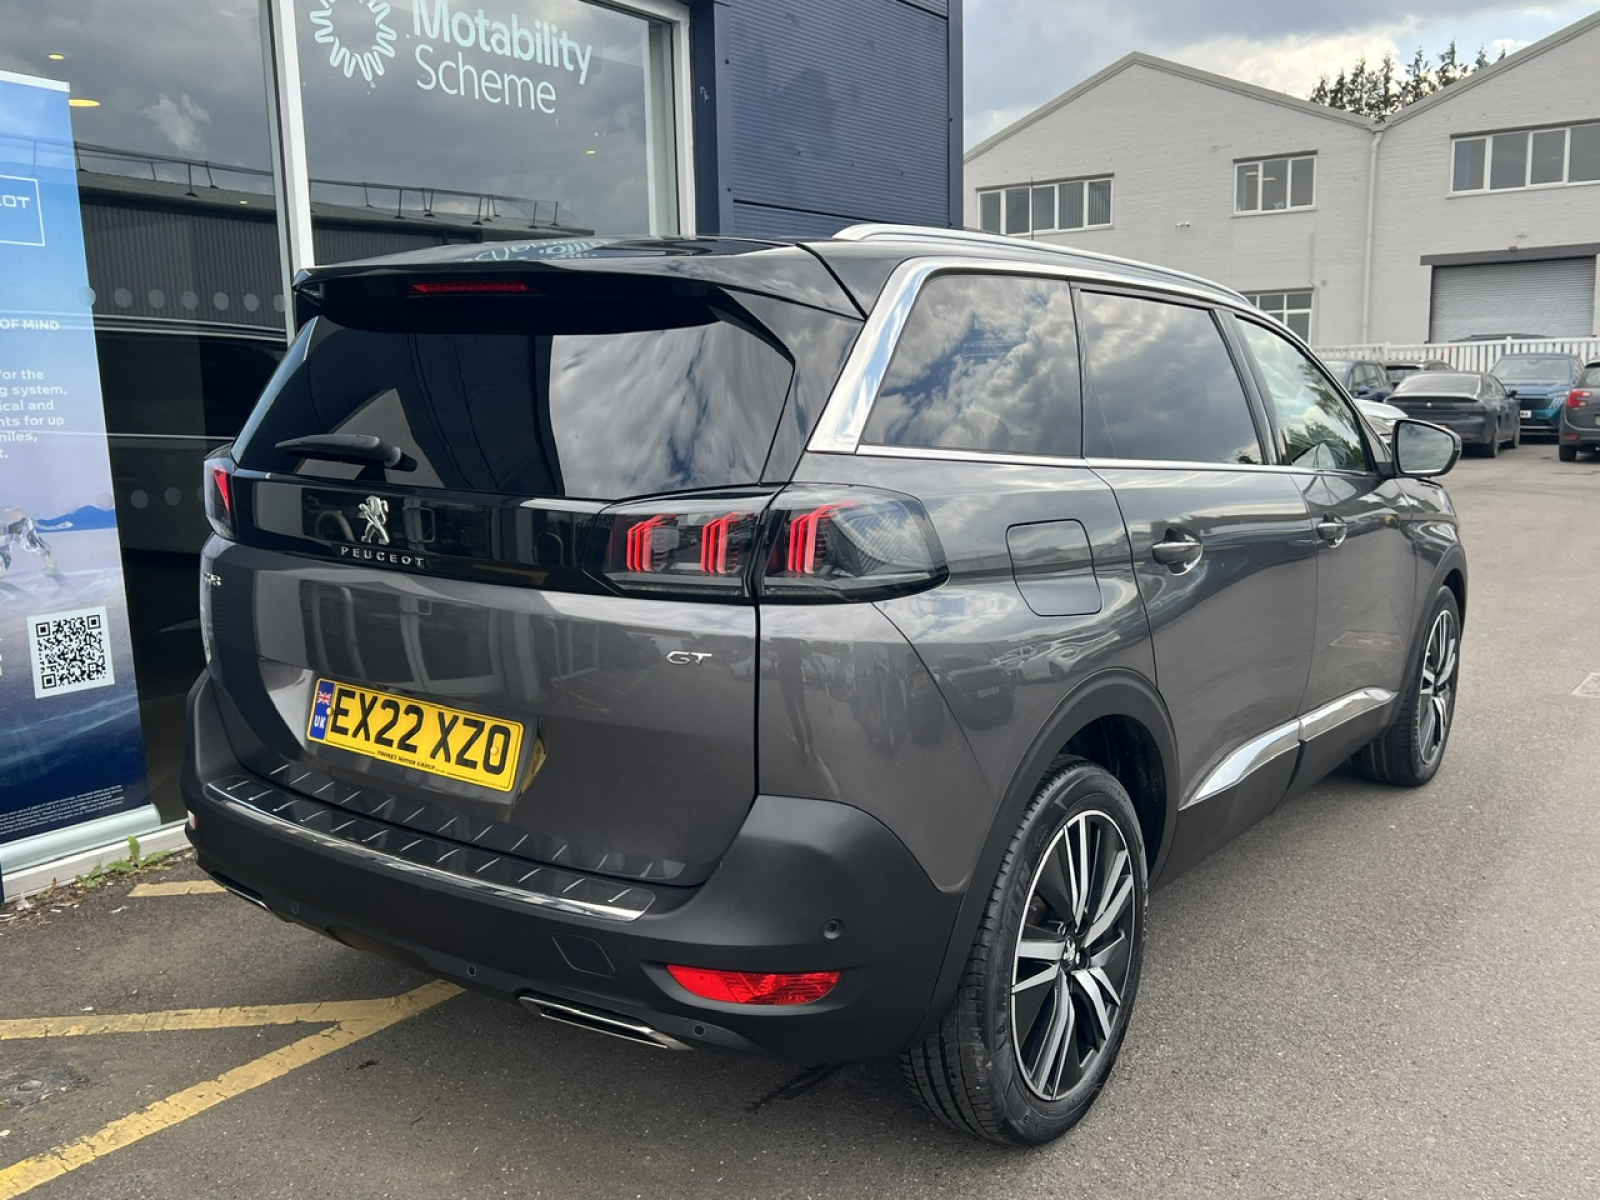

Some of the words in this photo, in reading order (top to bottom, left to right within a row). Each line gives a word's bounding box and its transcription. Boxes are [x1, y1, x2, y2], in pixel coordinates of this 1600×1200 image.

[411, 0, 593, 86] Motability
[414, 44, 557, 115] Scheme
[0, 194, 31, 209] OT
[23, 319, 60, 331] MIND
[20, 369, 45, 380] the
[12, 385, 67, 398] system,
[28, 399, 55, 411] and
[23, 414, 45, 426] for
[47, 416, 65, 428] up
[340, 545, 425, 567] PEUGEOT
[665, 650, 713, 665] GT
[314, 714, 326, 730] UK
[330, 688, 424, 754] EX22
